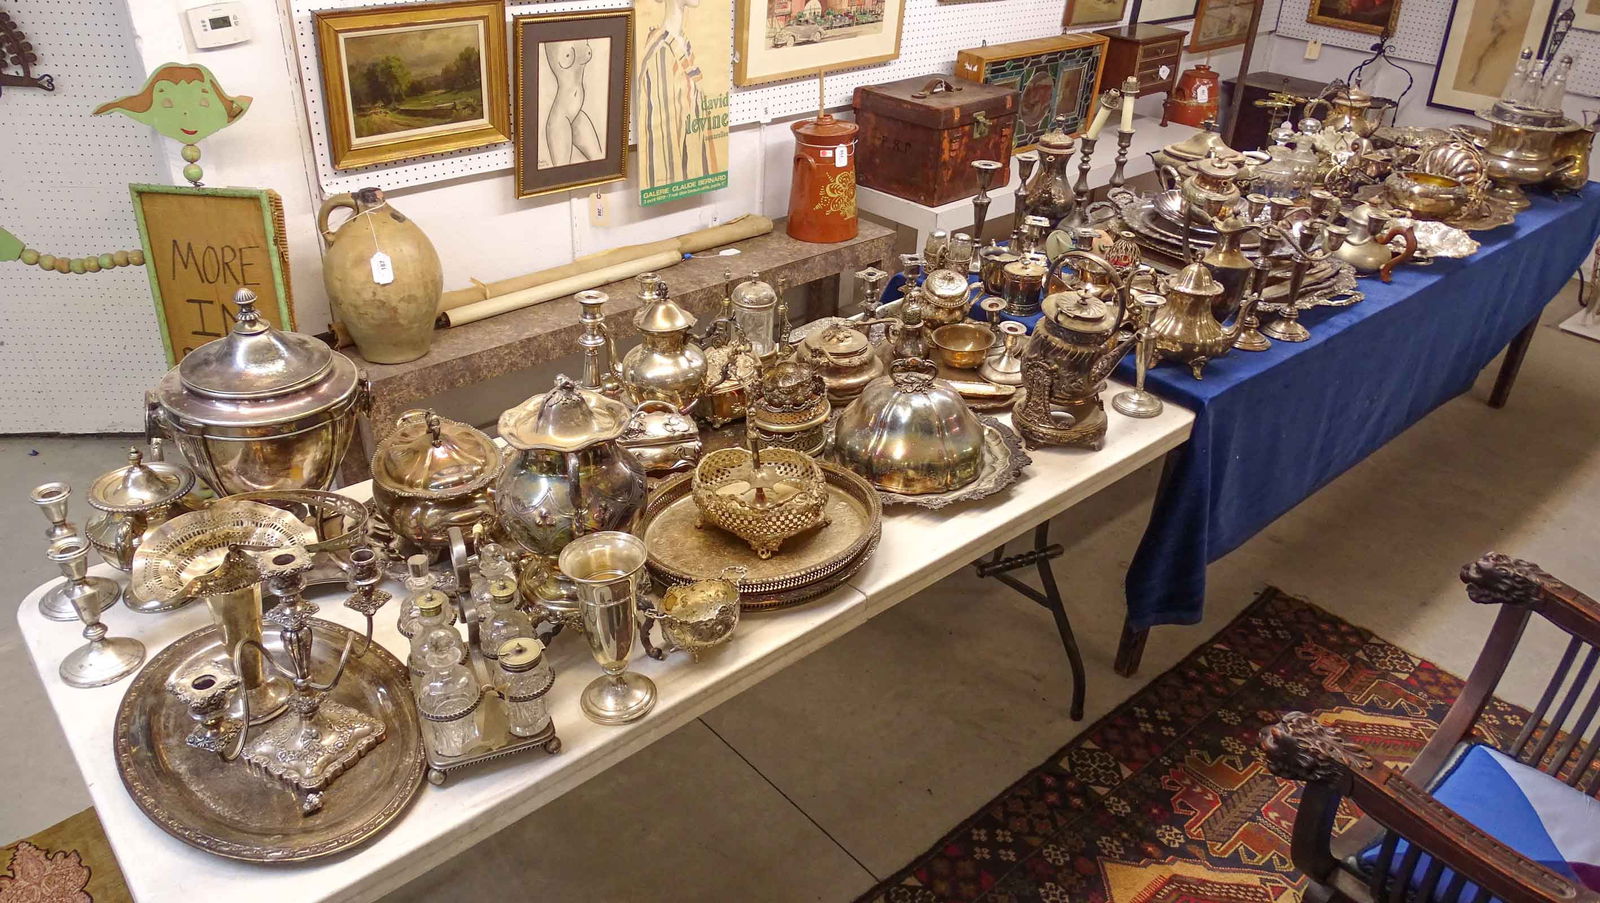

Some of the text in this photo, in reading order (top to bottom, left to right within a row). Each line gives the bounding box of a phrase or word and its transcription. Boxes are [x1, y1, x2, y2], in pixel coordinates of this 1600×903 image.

[701, 91, 729, 111] david
[685, 111, 729, 134] levine
[643, 187, 670, 199] GALERIE
[671, 181, 697, 192] CLAUDE
[697, 174, 727, 186] BERNARD
[172, 239, 261, 285] MORE
